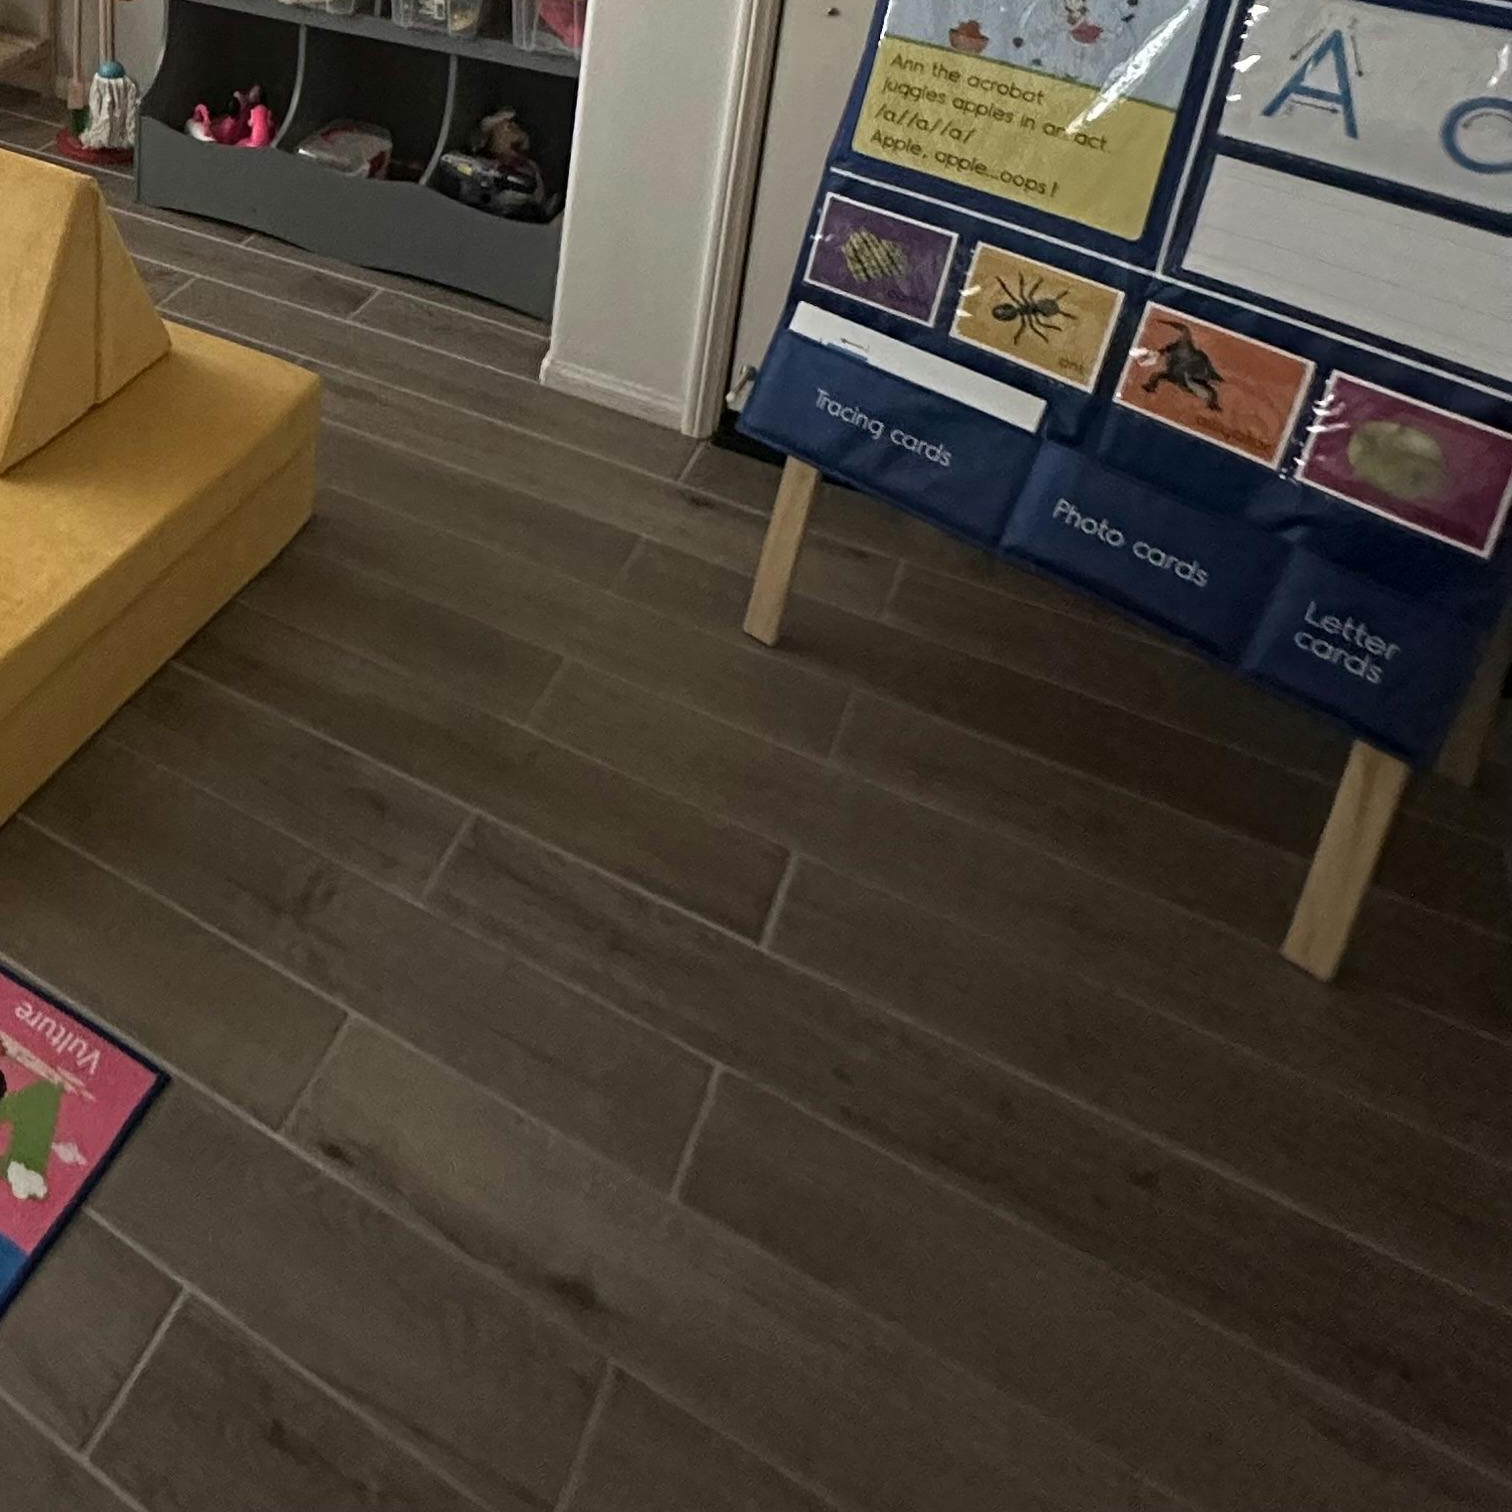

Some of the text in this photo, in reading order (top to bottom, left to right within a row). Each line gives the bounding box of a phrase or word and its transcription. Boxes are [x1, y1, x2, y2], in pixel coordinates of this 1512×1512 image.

[890, 53, 1045, 106] Ann the acrobat
[1260, 29, 1359, 140] A
[951, 95, 1014, 123] apples
[1020, 112, 1036, 130] in
[872, 128, 929, 161] Apple,
[814, 388, 954, 469] Tracing cards
[1051, 498, 1209, 589] Photo cards
[1293, 630, 1384, 686] cards
[1304, 599, 1399, 662] Letter
[13, 1000, 102, 1077] Vulture
